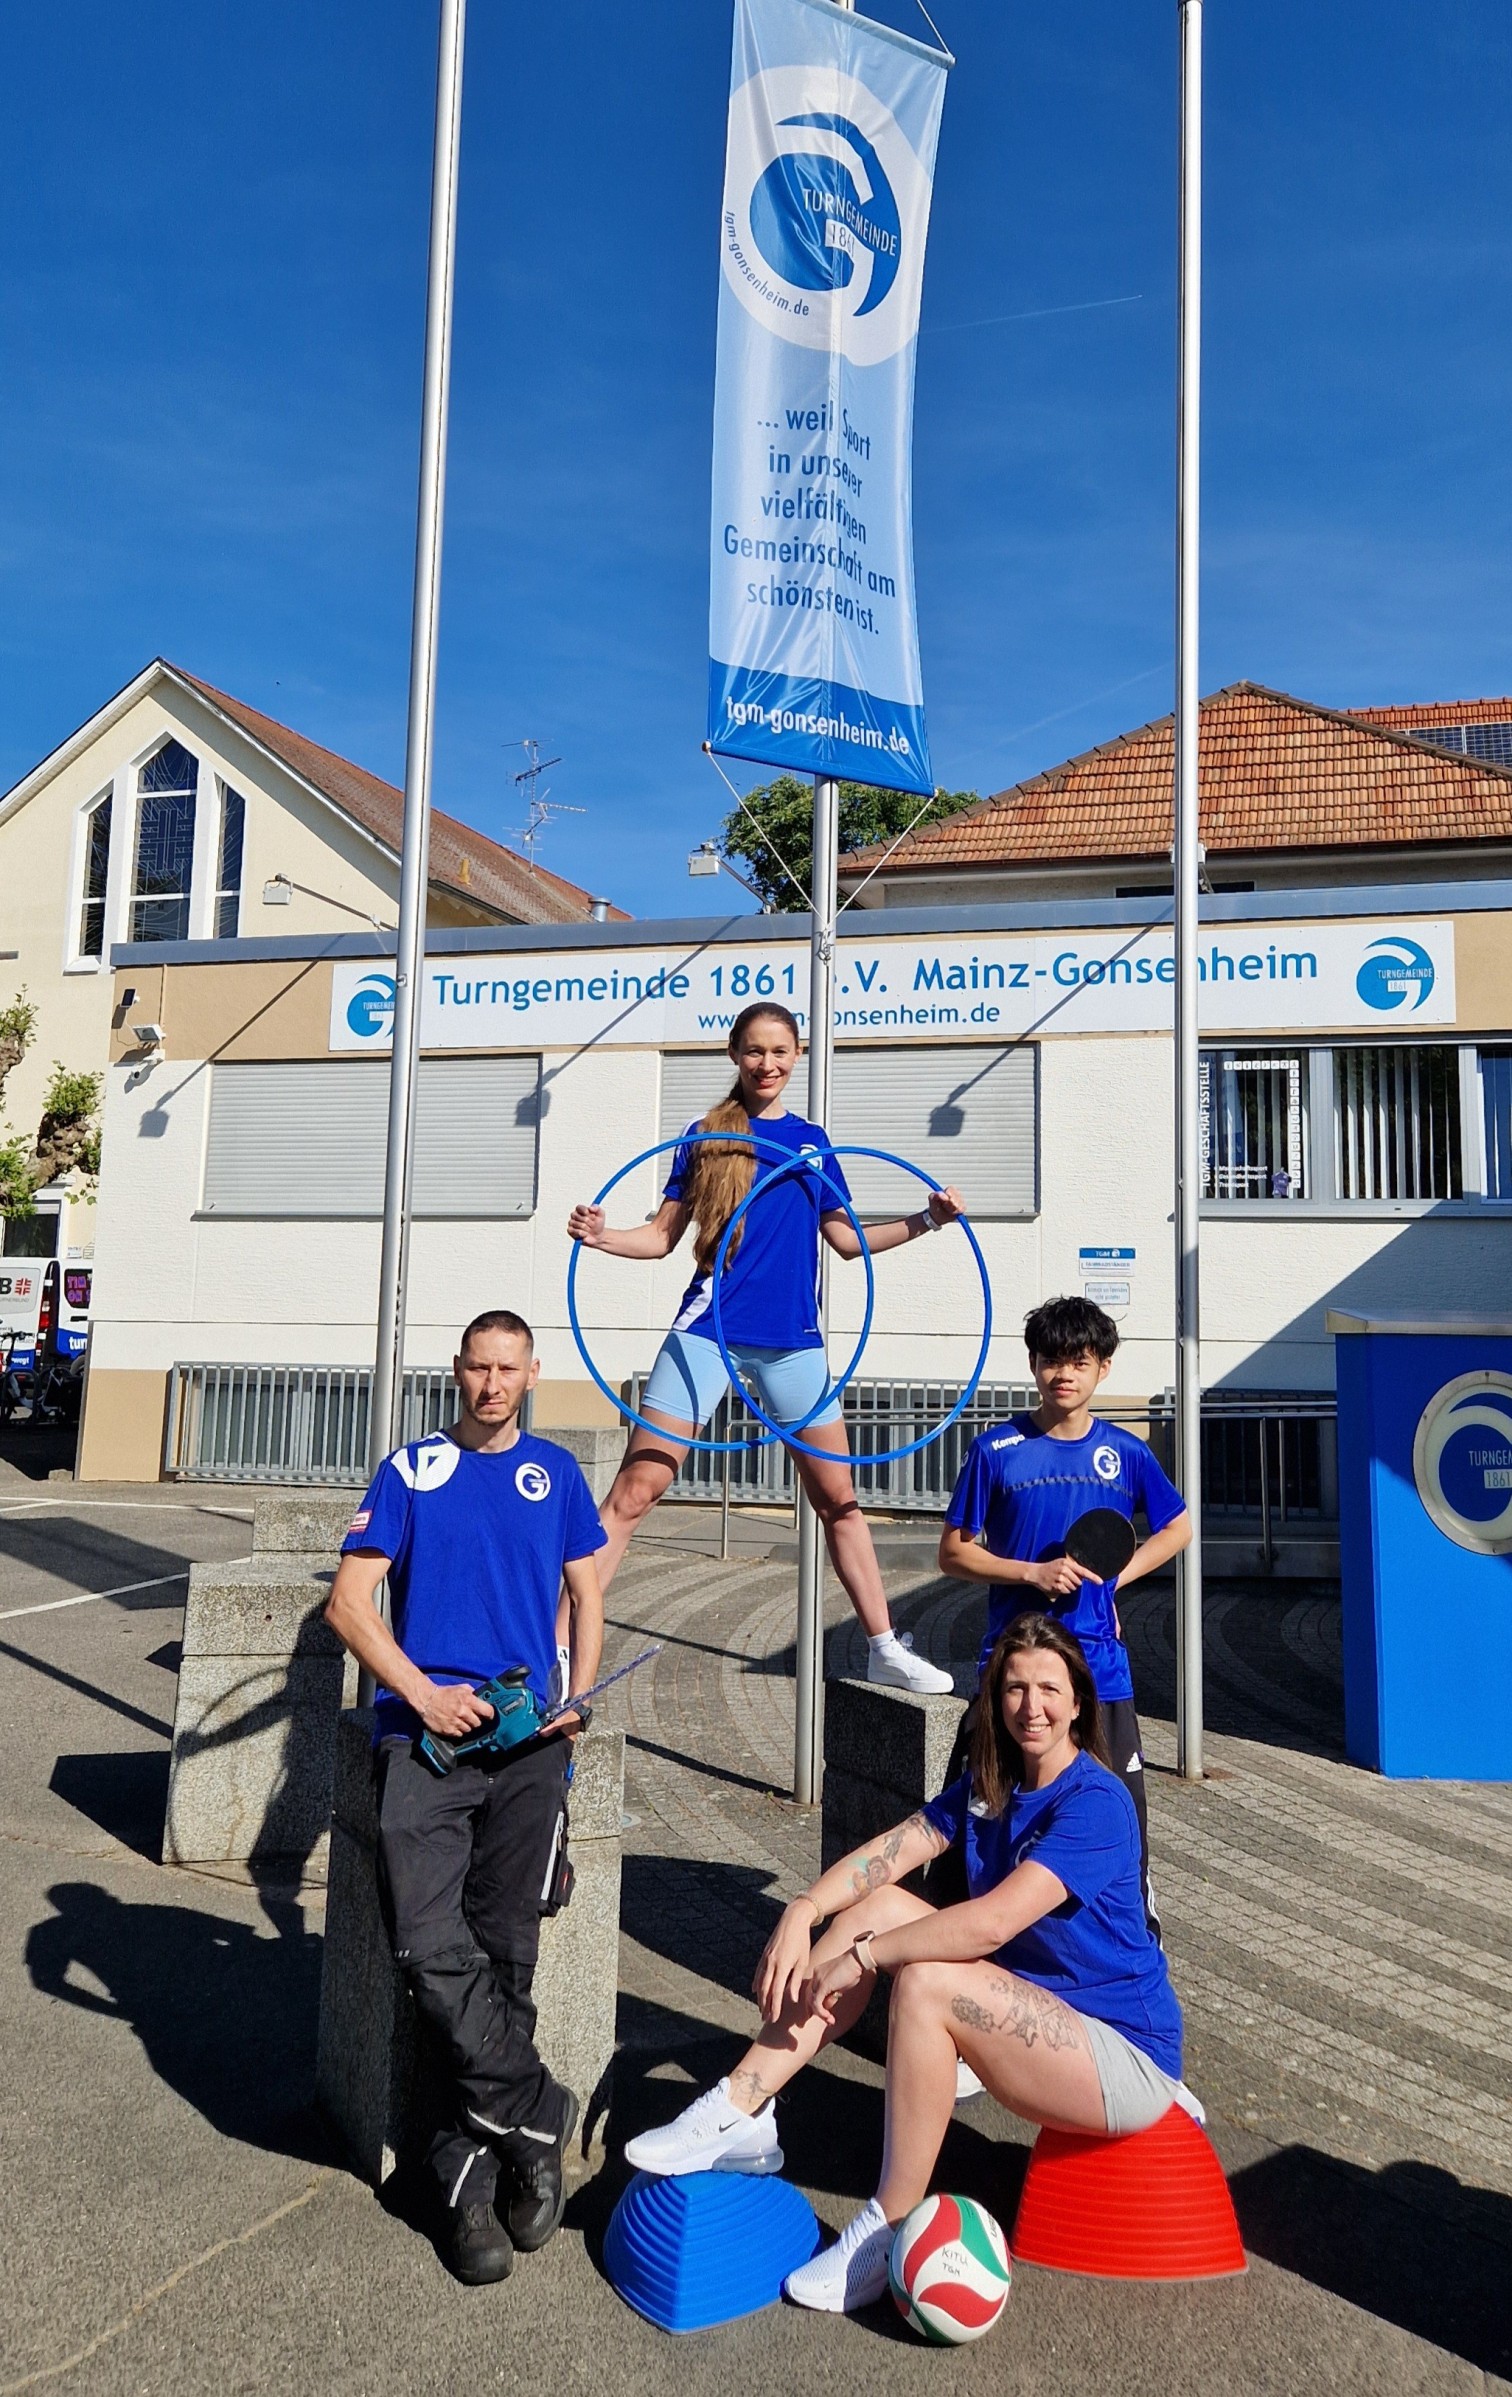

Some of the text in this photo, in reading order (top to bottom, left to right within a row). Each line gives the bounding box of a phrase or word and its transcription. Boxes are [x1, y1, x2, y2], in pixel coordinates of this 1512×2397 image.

[802, 188, 897, 256] TURNGEMEINDE
[724, 211, 809, 316] tgm-gonsenheim.de
[785, 400, 834, 431] weil
[842, 407, 871, 461] Sport
[769, 444, 863, 498] in unserer
[760, 487, 867, 545] vielfältigen
[724, 523, 896, 598] Gemeinschaft am
[747, 574, 880, 635] schönsten ist.
[725, 695, 910, 756] tgm-gonsenheim.de
[432, 966, 691, 1012] Turngemeinde
[710, 962, 795, 997] 1861
[1376, 966, 1433, 979] TURNGEMEINDE
[1486, 1471, 1511, 1488] 1861
